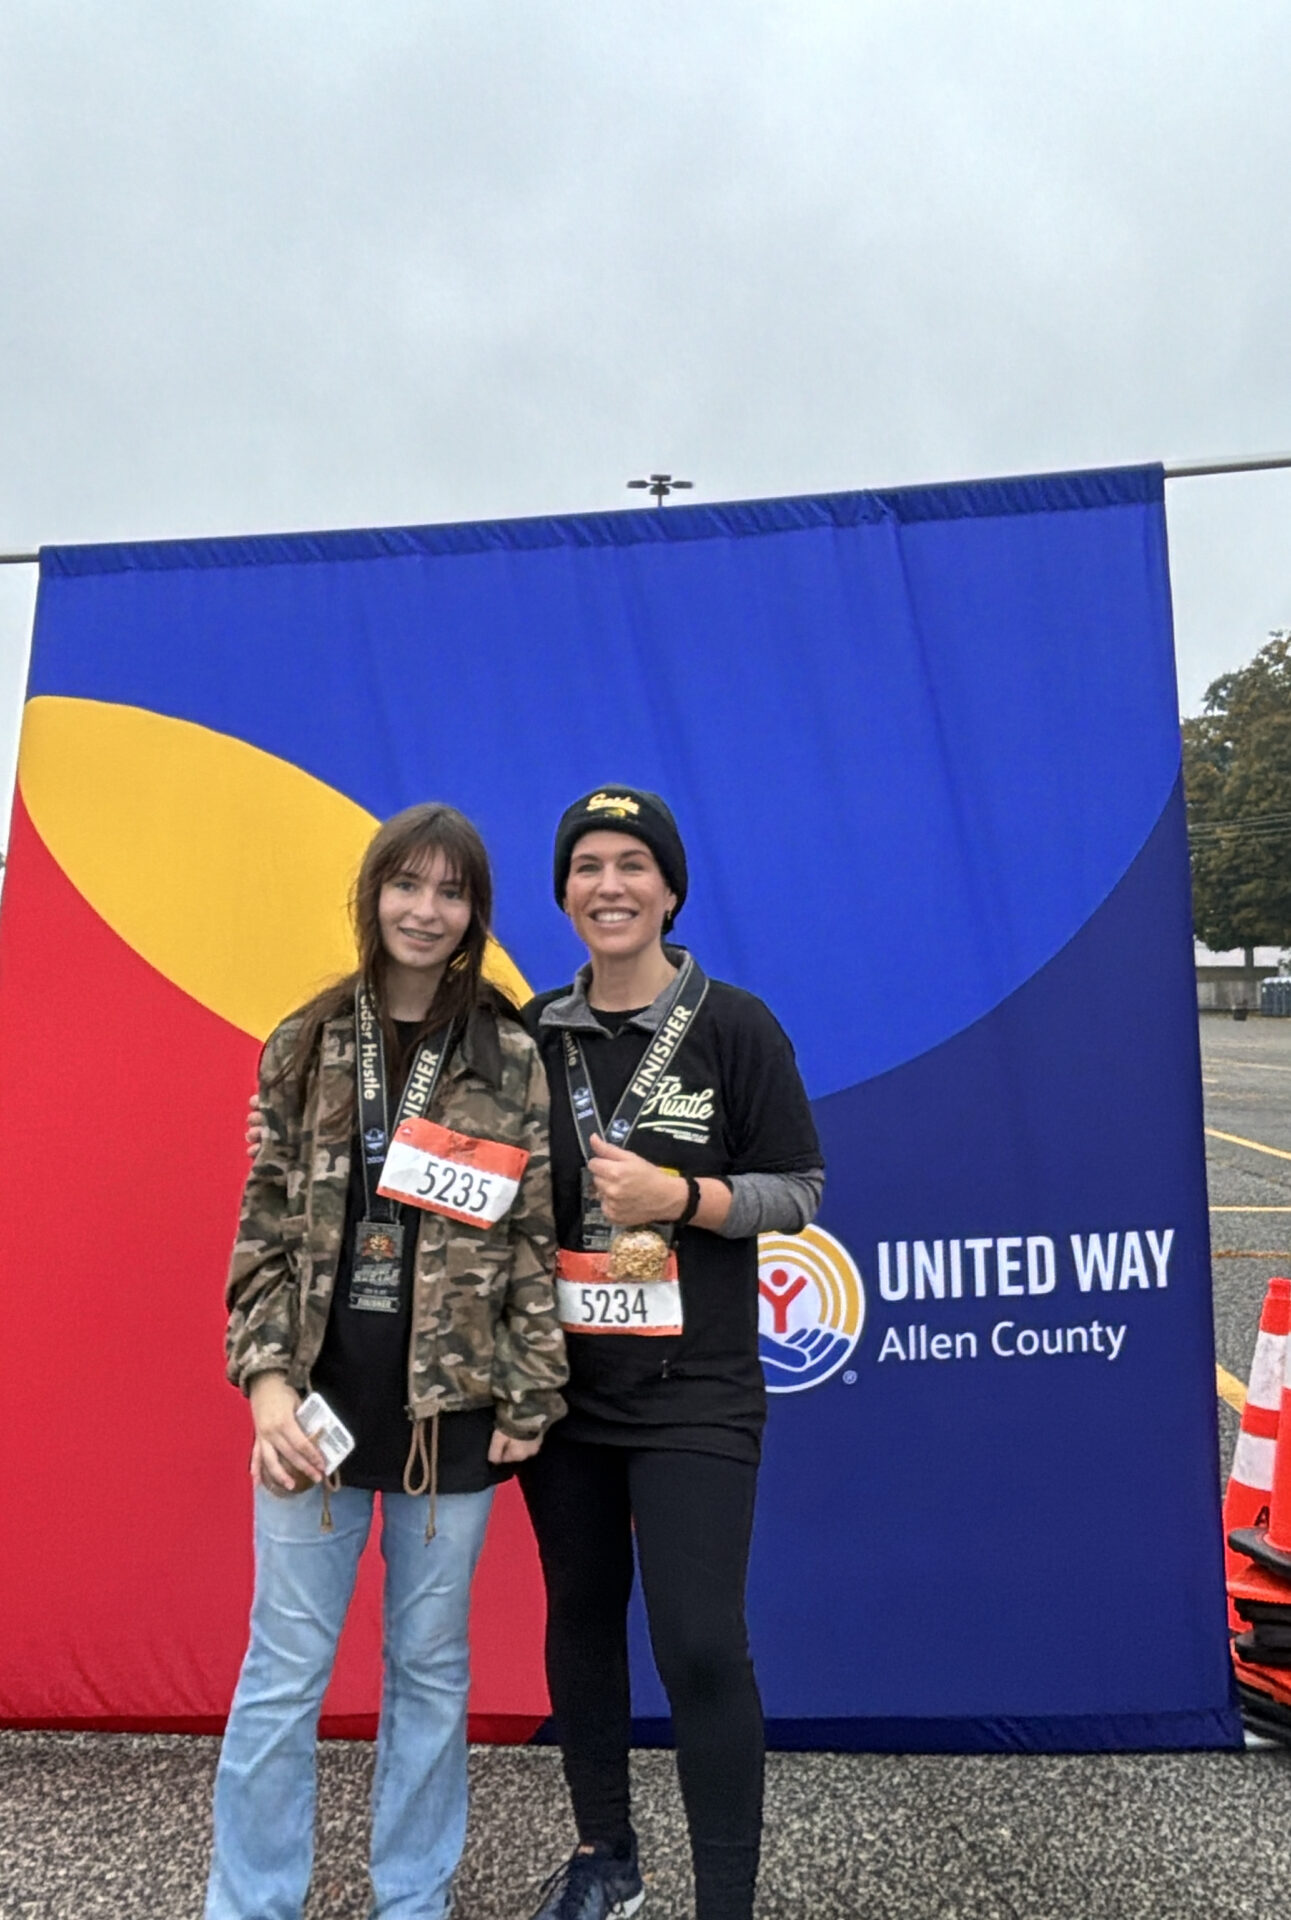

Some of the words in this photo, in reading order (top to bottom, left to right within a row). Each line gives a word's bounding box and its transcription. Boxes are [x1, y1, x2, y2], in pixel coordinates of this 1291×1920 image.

[362, 1043, 381, 1100] Hustle
[631, 1005, 693, 1098] FINISHER
[641, 1081, 715, 1120] Hustle
[416, 1161, 492, 1213] 5235
[878, 1236, 1056, 1301] UNITED
[1070, 1229, 1175, 1293] WAY
[581, 1288, 648, 1324] 5234
[878, 1324, 978, 1362] Allen
[991, 1320, 1127, 1360] County
